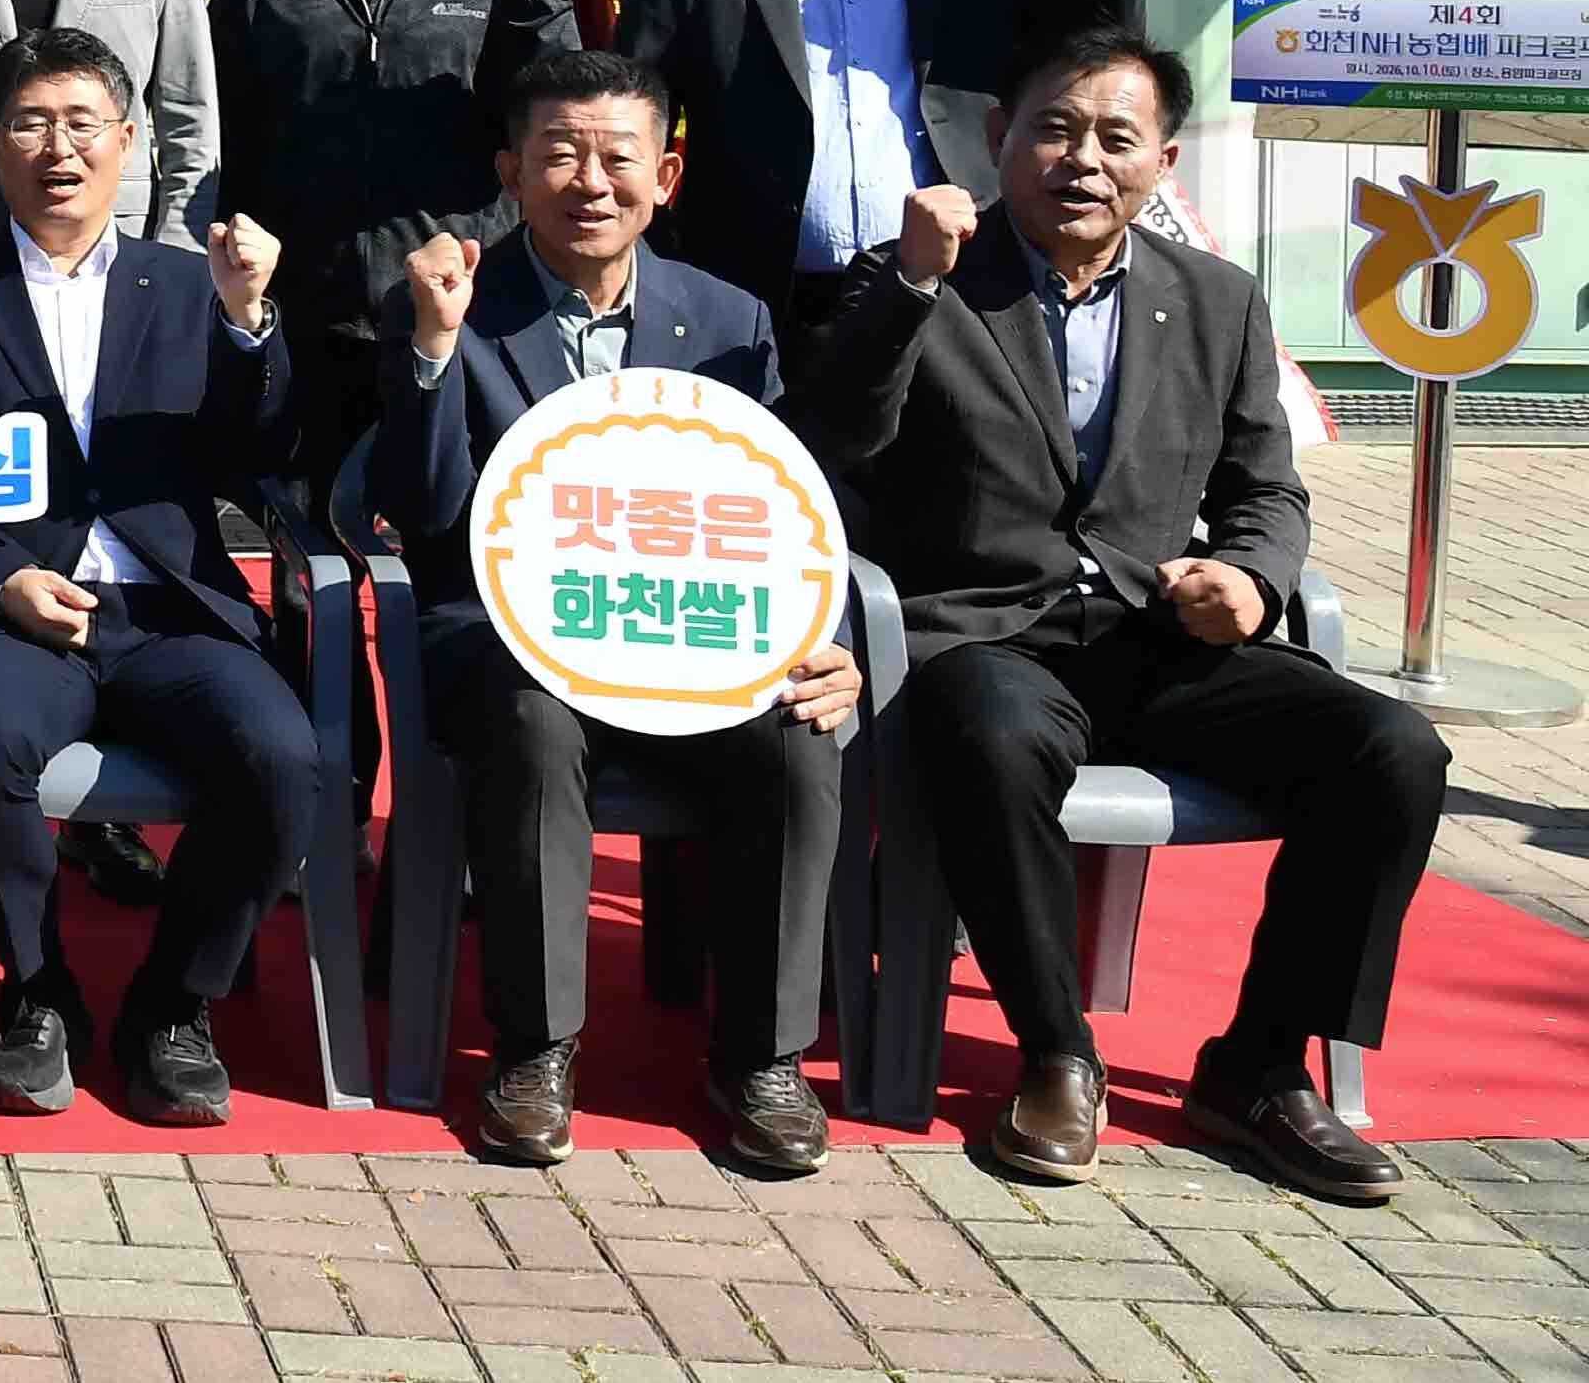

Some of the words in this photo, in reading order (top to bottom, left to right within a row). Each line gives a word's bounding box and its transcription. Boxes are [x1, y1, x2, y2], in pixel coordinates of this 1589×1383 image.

[1429, 4, 1502, 26] 제4회
[1303, 29, 1356, 54] 화천
[551, 483, 773, 563] 맛좋은
[551, 568, 770, 654] 화천쌀!
